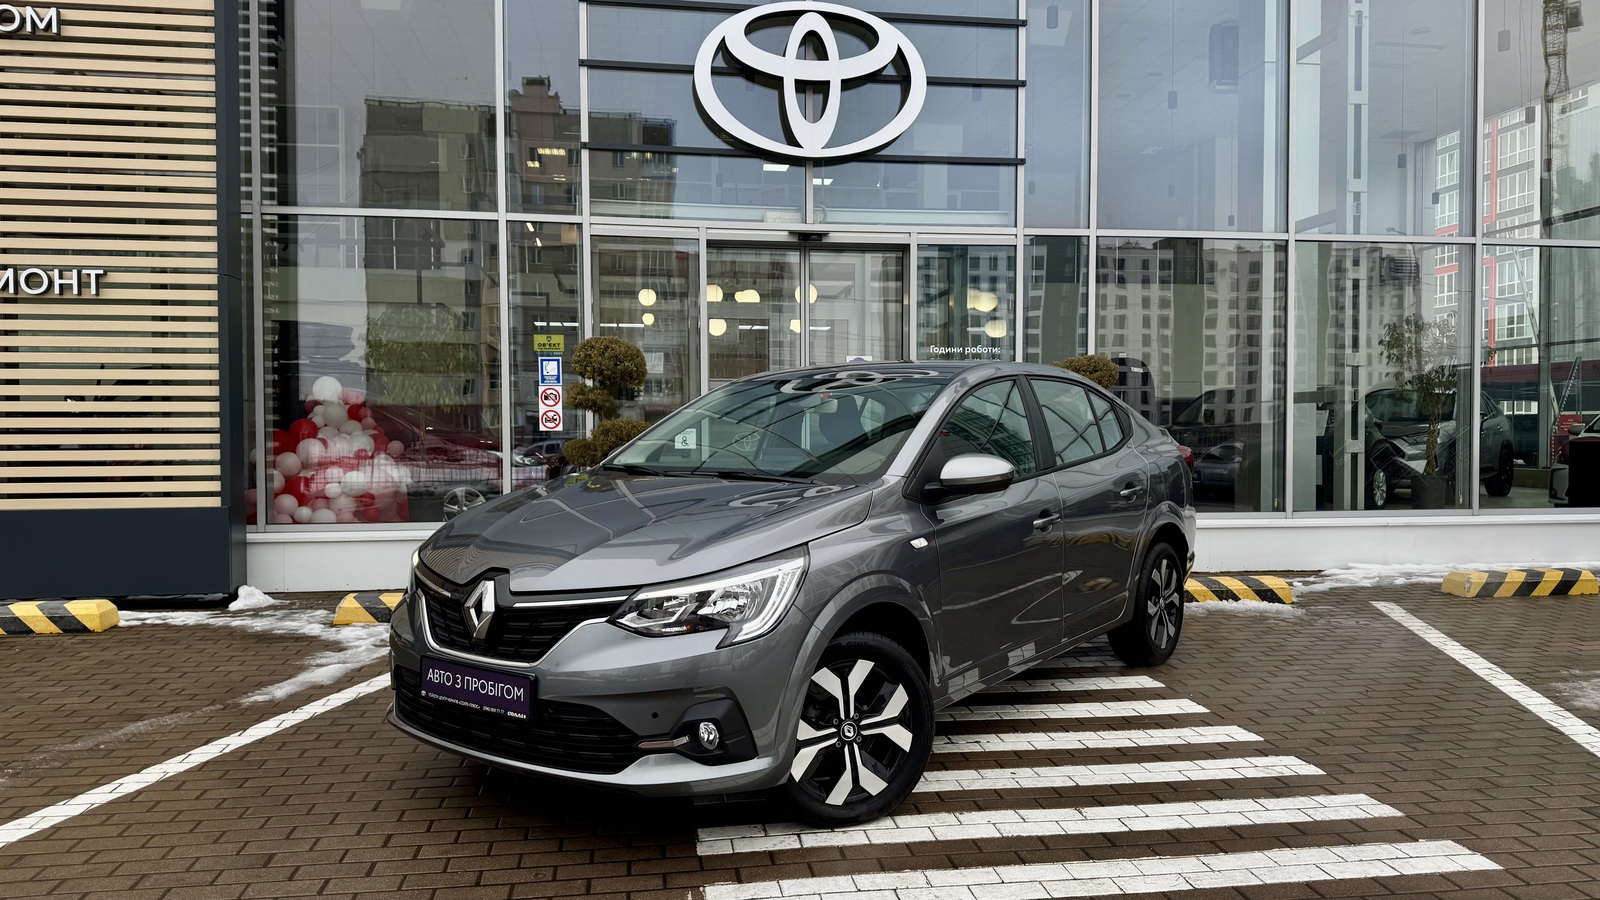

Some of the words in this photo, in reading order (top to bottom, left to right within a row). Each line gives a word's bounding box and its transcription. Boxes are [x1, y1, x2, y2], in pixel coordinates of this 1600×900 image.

[929, 344, 963, 354] Години
[965, 344, 1001, 355] роботи:
[427, 668, 453, 686] АВТО
[464, 676, 524, 702] ПРОБІГОМ
